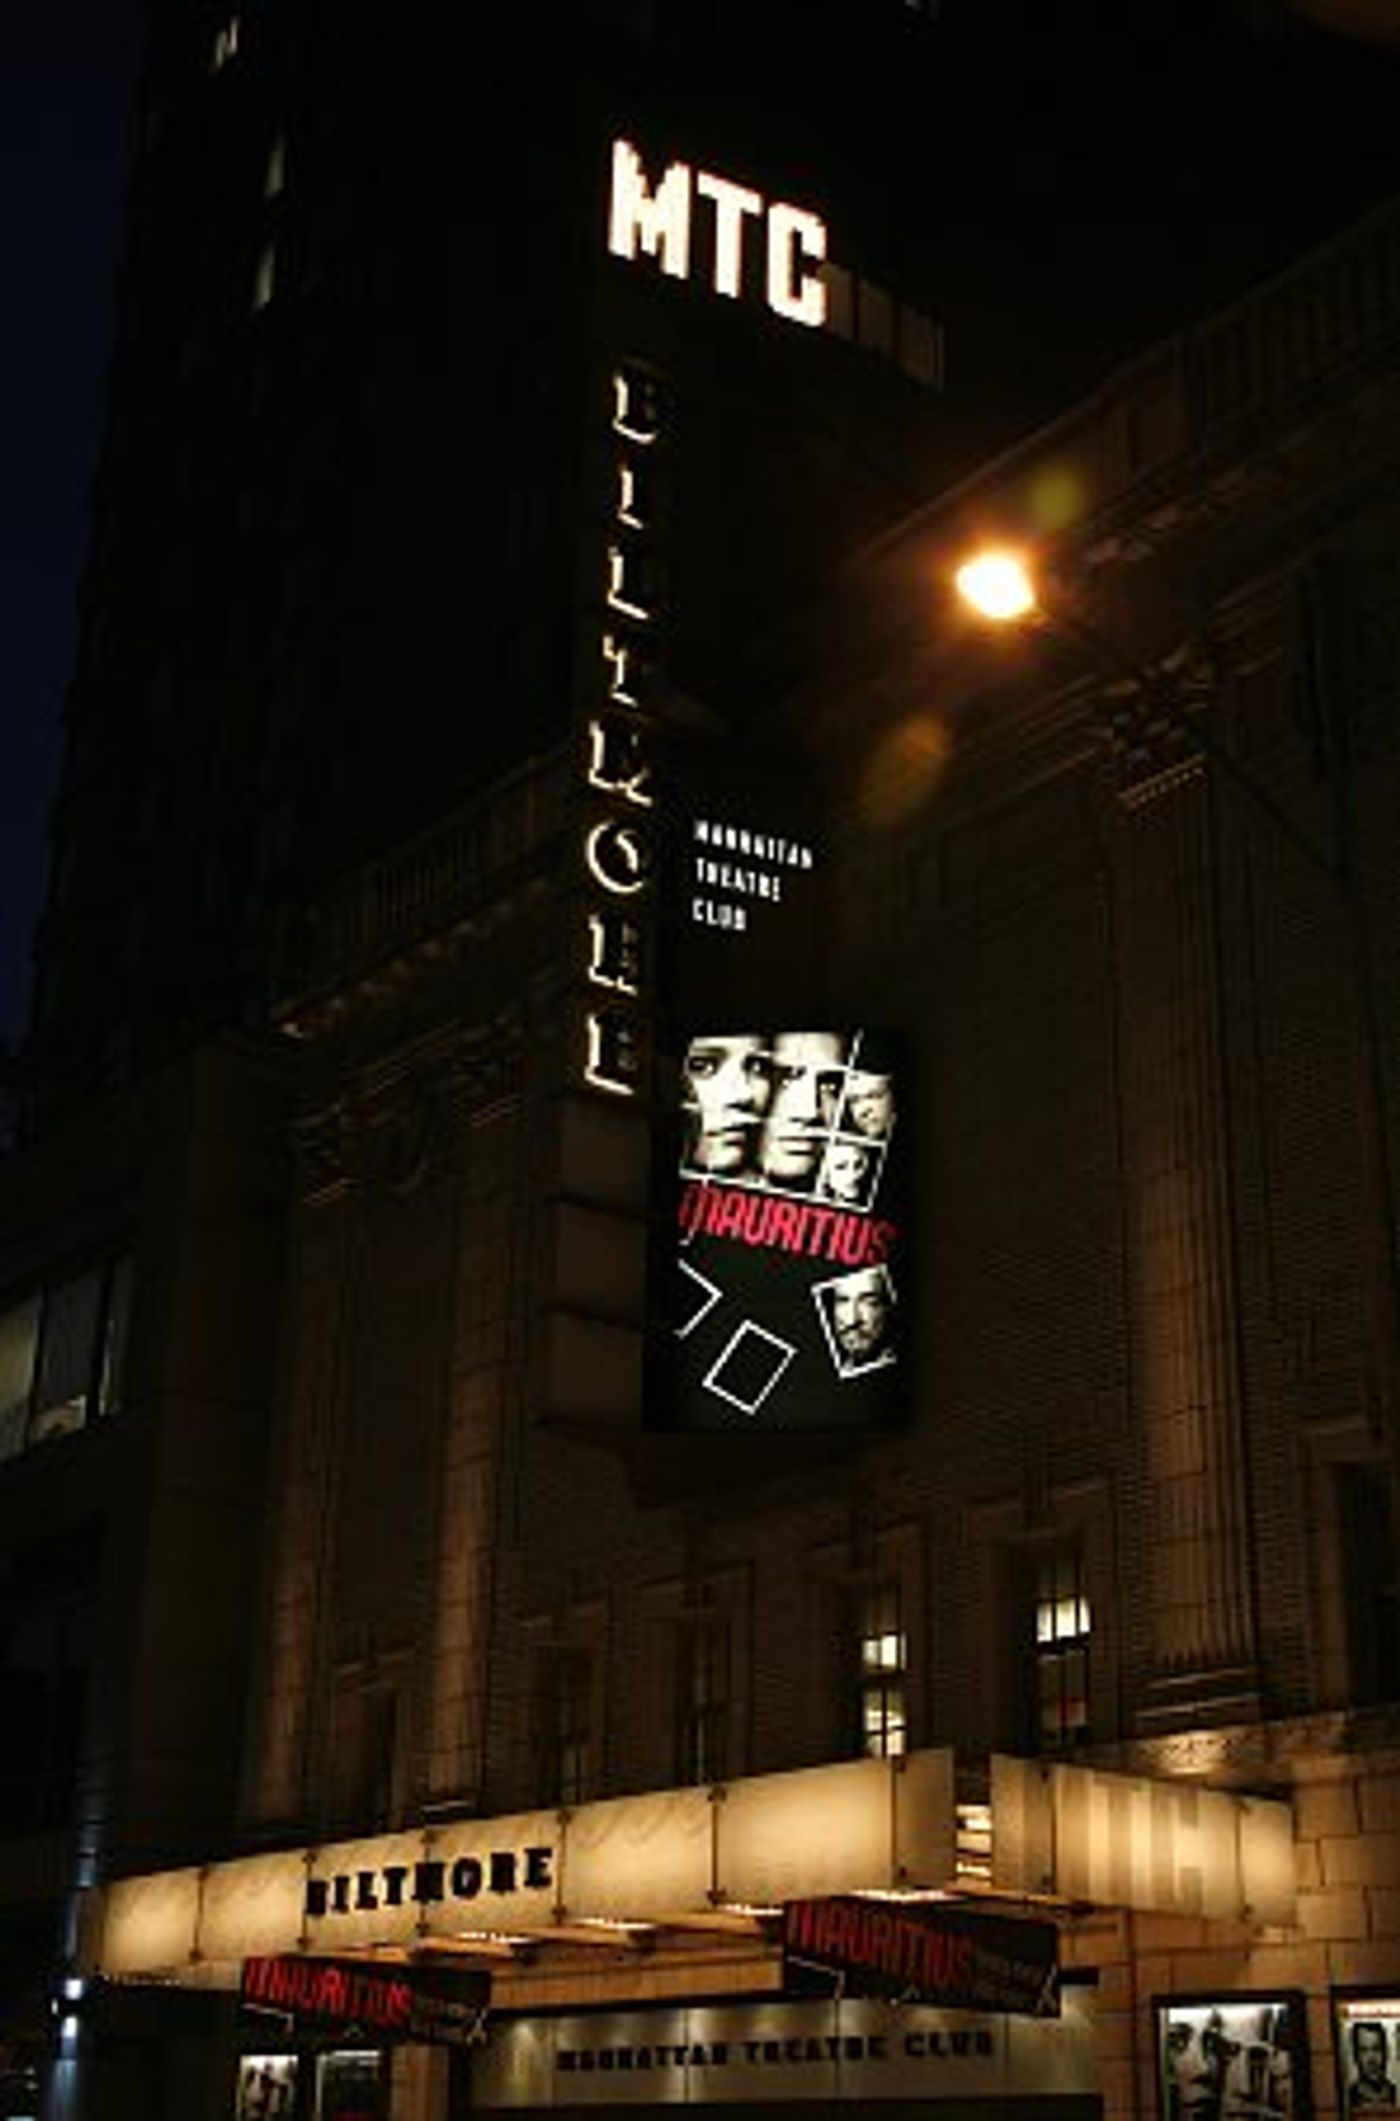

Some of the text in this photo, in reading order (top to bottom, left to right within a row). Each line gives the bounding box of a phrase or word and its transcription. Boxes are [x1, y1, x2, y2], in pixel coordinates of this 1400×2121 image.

[608, 138, 828, 329] MTC
[694, 856, 783, 903] THEATRE
[691, 898, 748, 932] CLUB
[677, 1183, 897, 1268] MAURITIUS
[306, 1848, 553, 1915] BILTMORE
